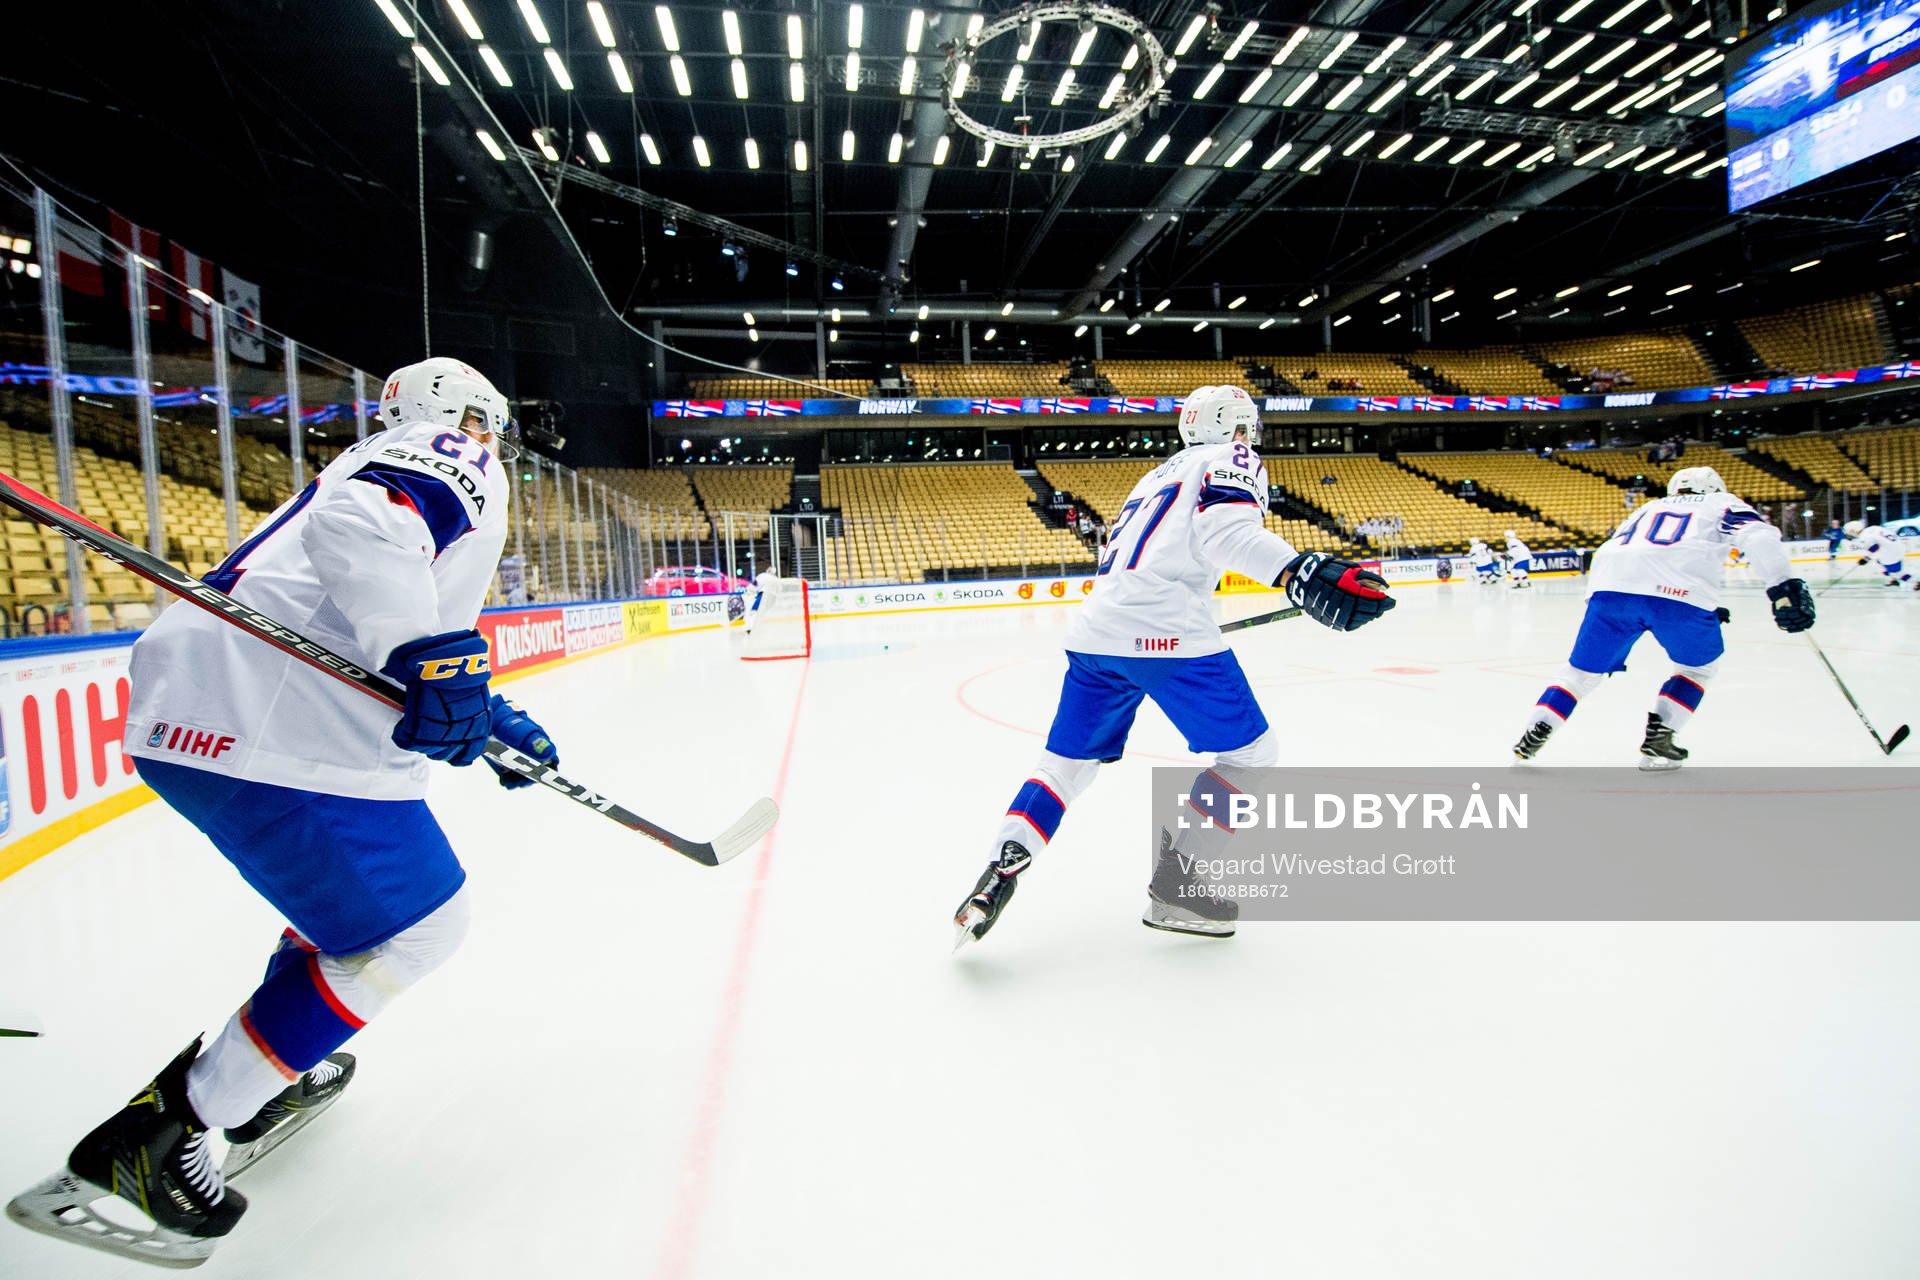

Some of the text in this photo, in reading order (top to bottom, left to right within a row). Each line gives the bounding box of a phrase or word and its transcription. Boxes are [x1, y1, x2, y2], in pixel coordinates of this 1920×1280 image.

[385, 381, 400, 400] 21
[858, 400, 917, 414] NORWAY
[1265, 398, 1314, 411] NORWAY
[1185, 410, 1198, 425] 27
[430, 431, 491, 477] 21
[382, 447, 486, 516] ŠKODA
[1213, 468, 1266, 508] ŠKODA
[799, 503, 814, 511] L10
[1098, 481, 1183, 576] 27
[51, 525, 125, 564] CCM
[1400, 564, 1433, 573] TISSOT
[874, 592, 926, 604] ŠKODA
[953, 588, 1004, 600] ŠKODA
[1663, 586, 1690, 598] IIHF
[684, 601, 723, 616] TISSOT
[158, 572, 368, 680] JETSPEED
[495, 616, 564, 667] KRUŠOVICE
[1145, 638, 1180, 651] IIHF
[168, 726, 236, 759] IIHF
[500, 747, 617, 814] CCM
